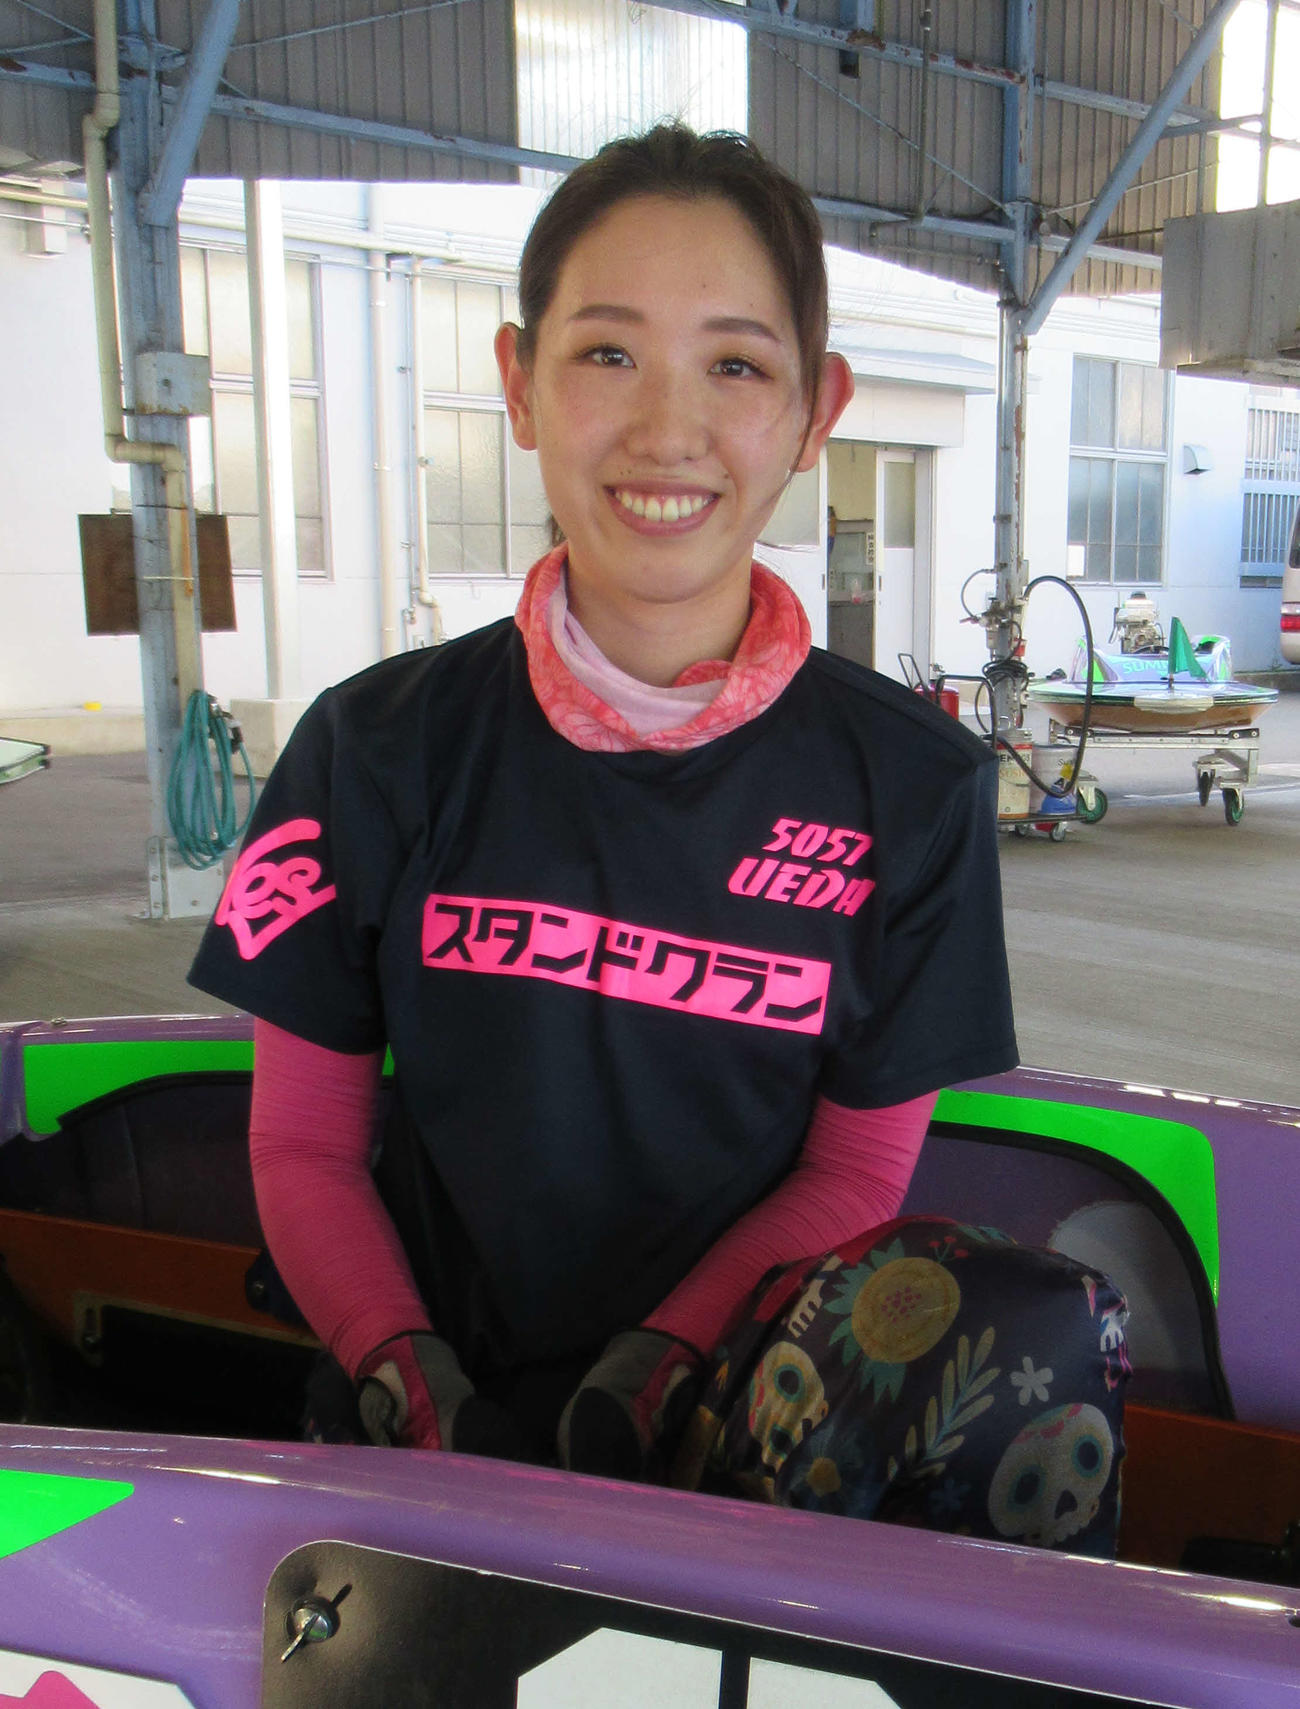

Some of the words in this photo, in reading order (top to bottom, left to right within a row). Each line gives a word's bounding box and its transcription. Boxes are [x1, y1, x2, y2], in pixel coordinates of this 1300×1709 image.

[762, 817, 873, 867] 5057
[728, 857, 876, 917] UEDA
[427, 902, 823, 1023] スタンドクラン
